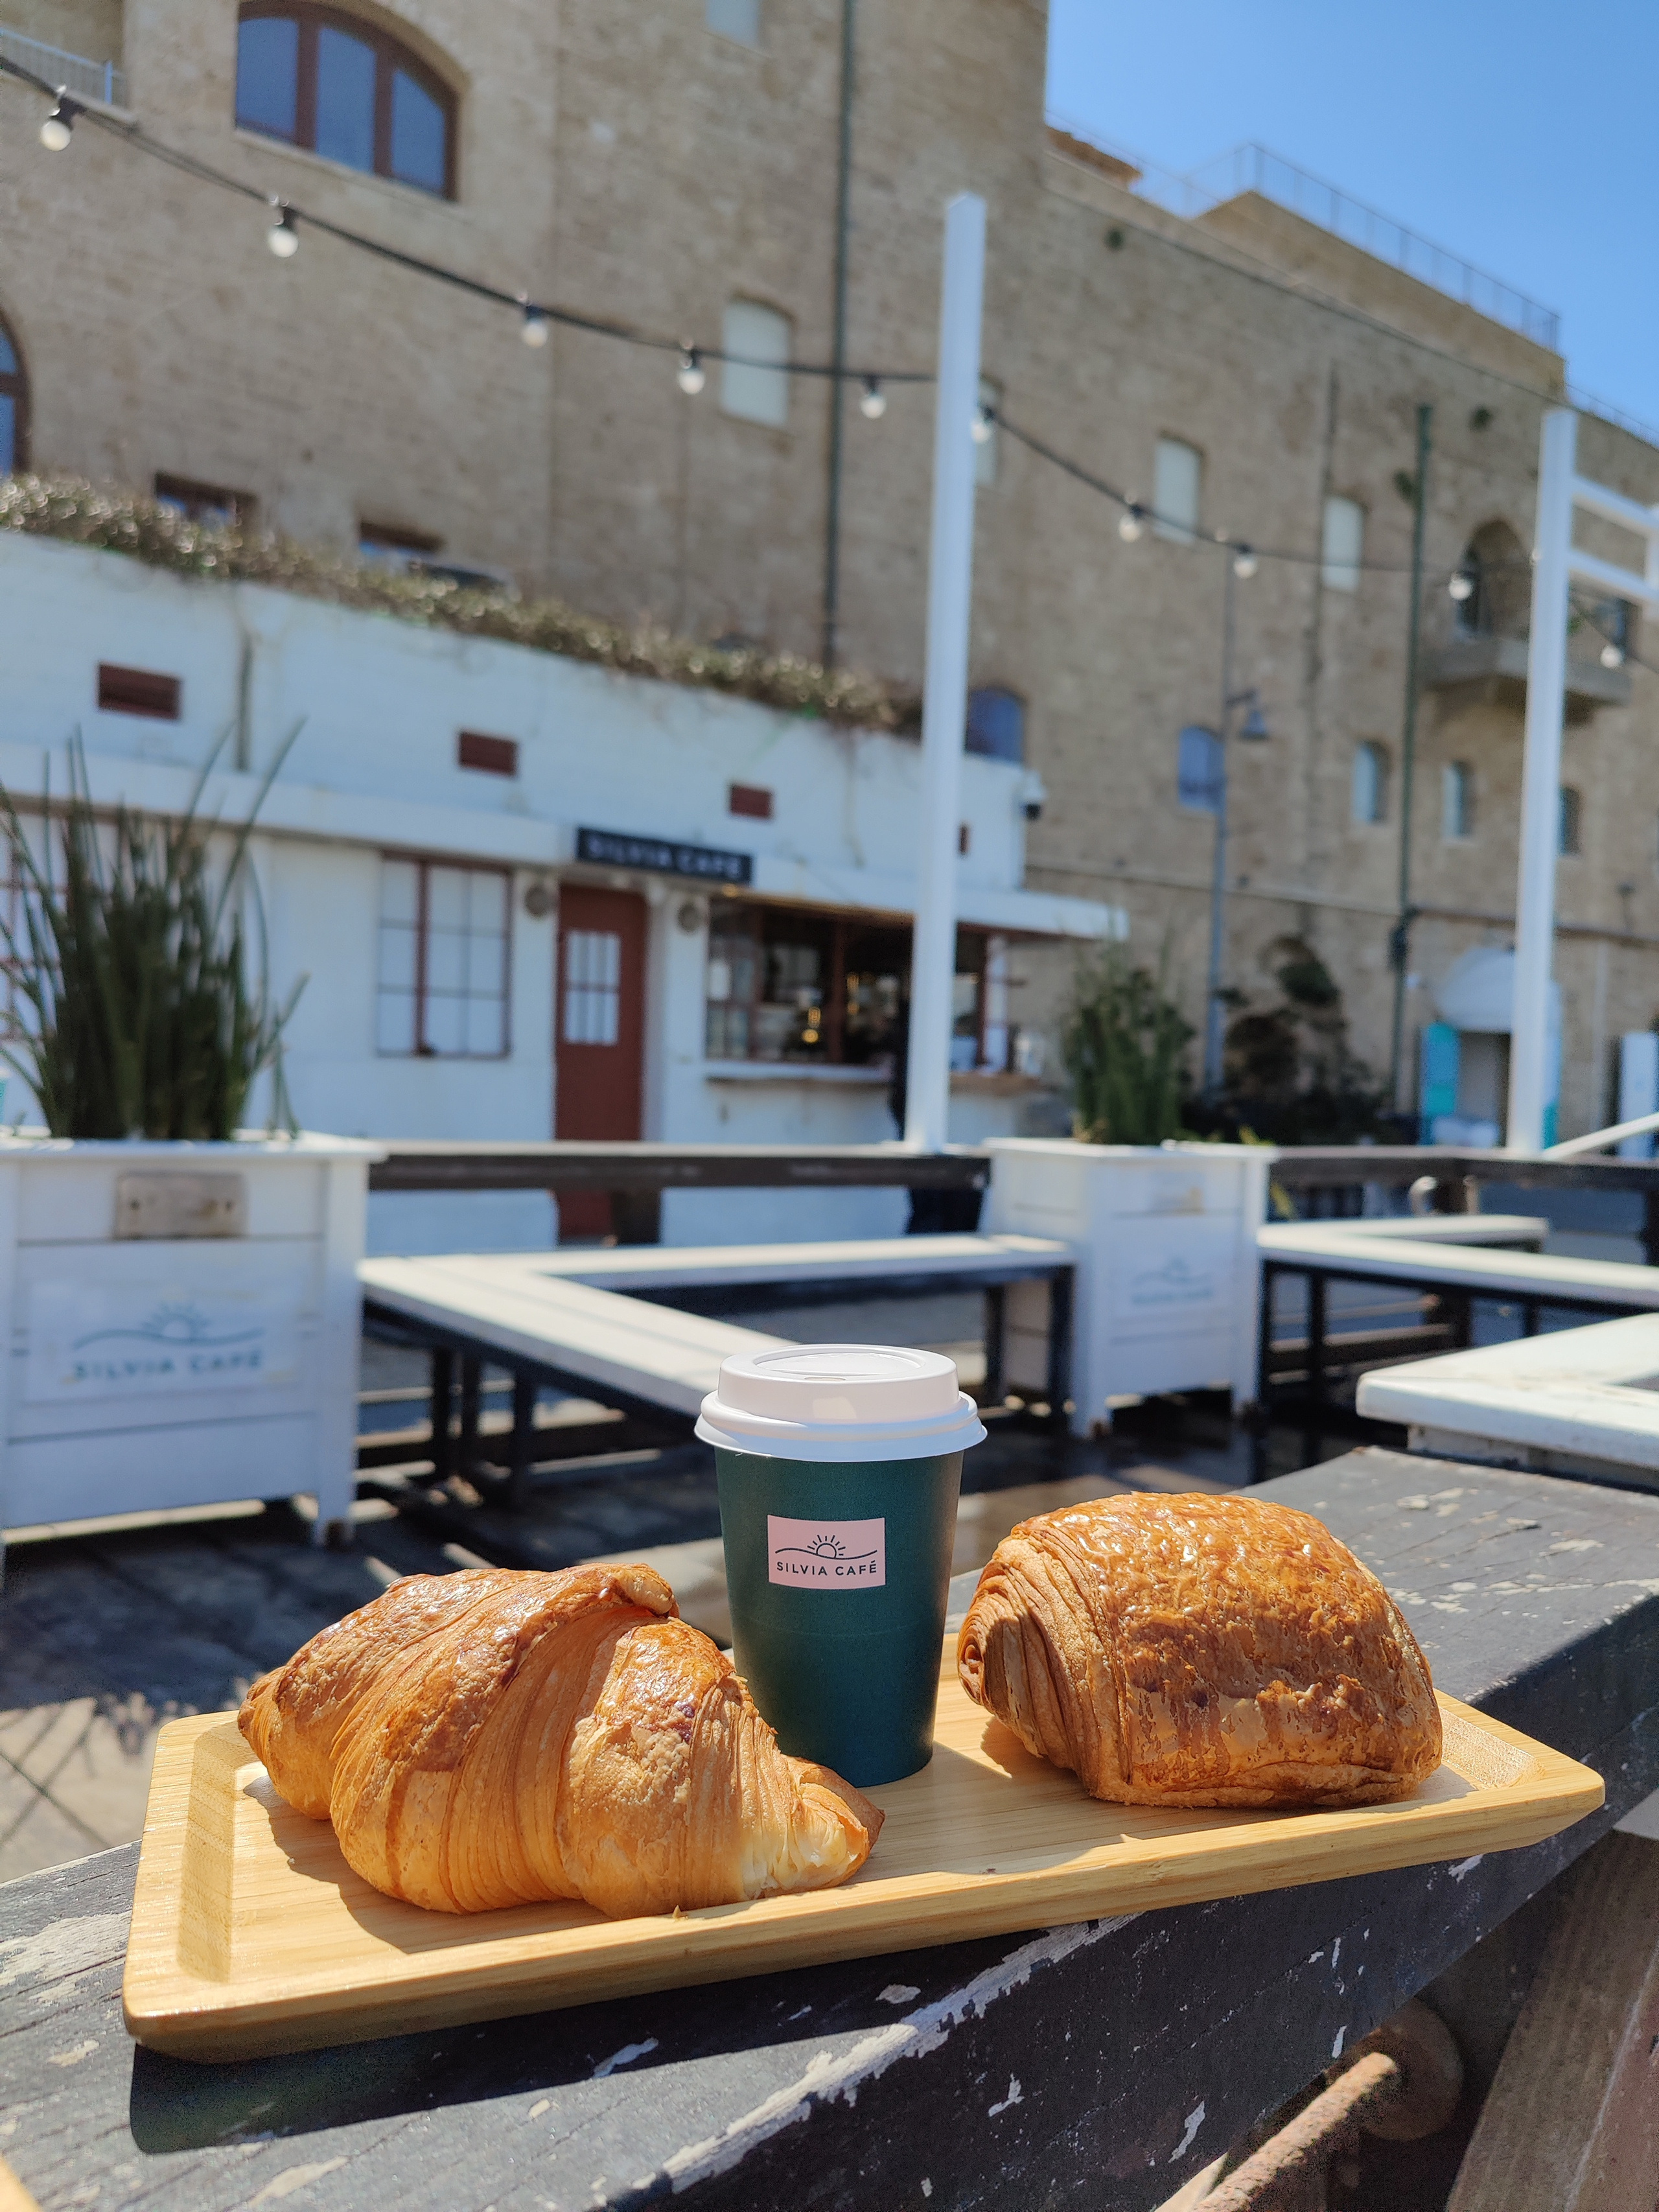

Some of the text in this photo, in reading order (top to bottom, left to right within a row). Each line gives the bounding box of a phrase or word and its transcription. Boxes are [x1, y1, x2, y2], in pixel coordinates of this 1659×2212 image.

[73, 1359, 175, 1380] SILVIA
[776, 1560, 877, 1576] SILVIA CAFÉ
